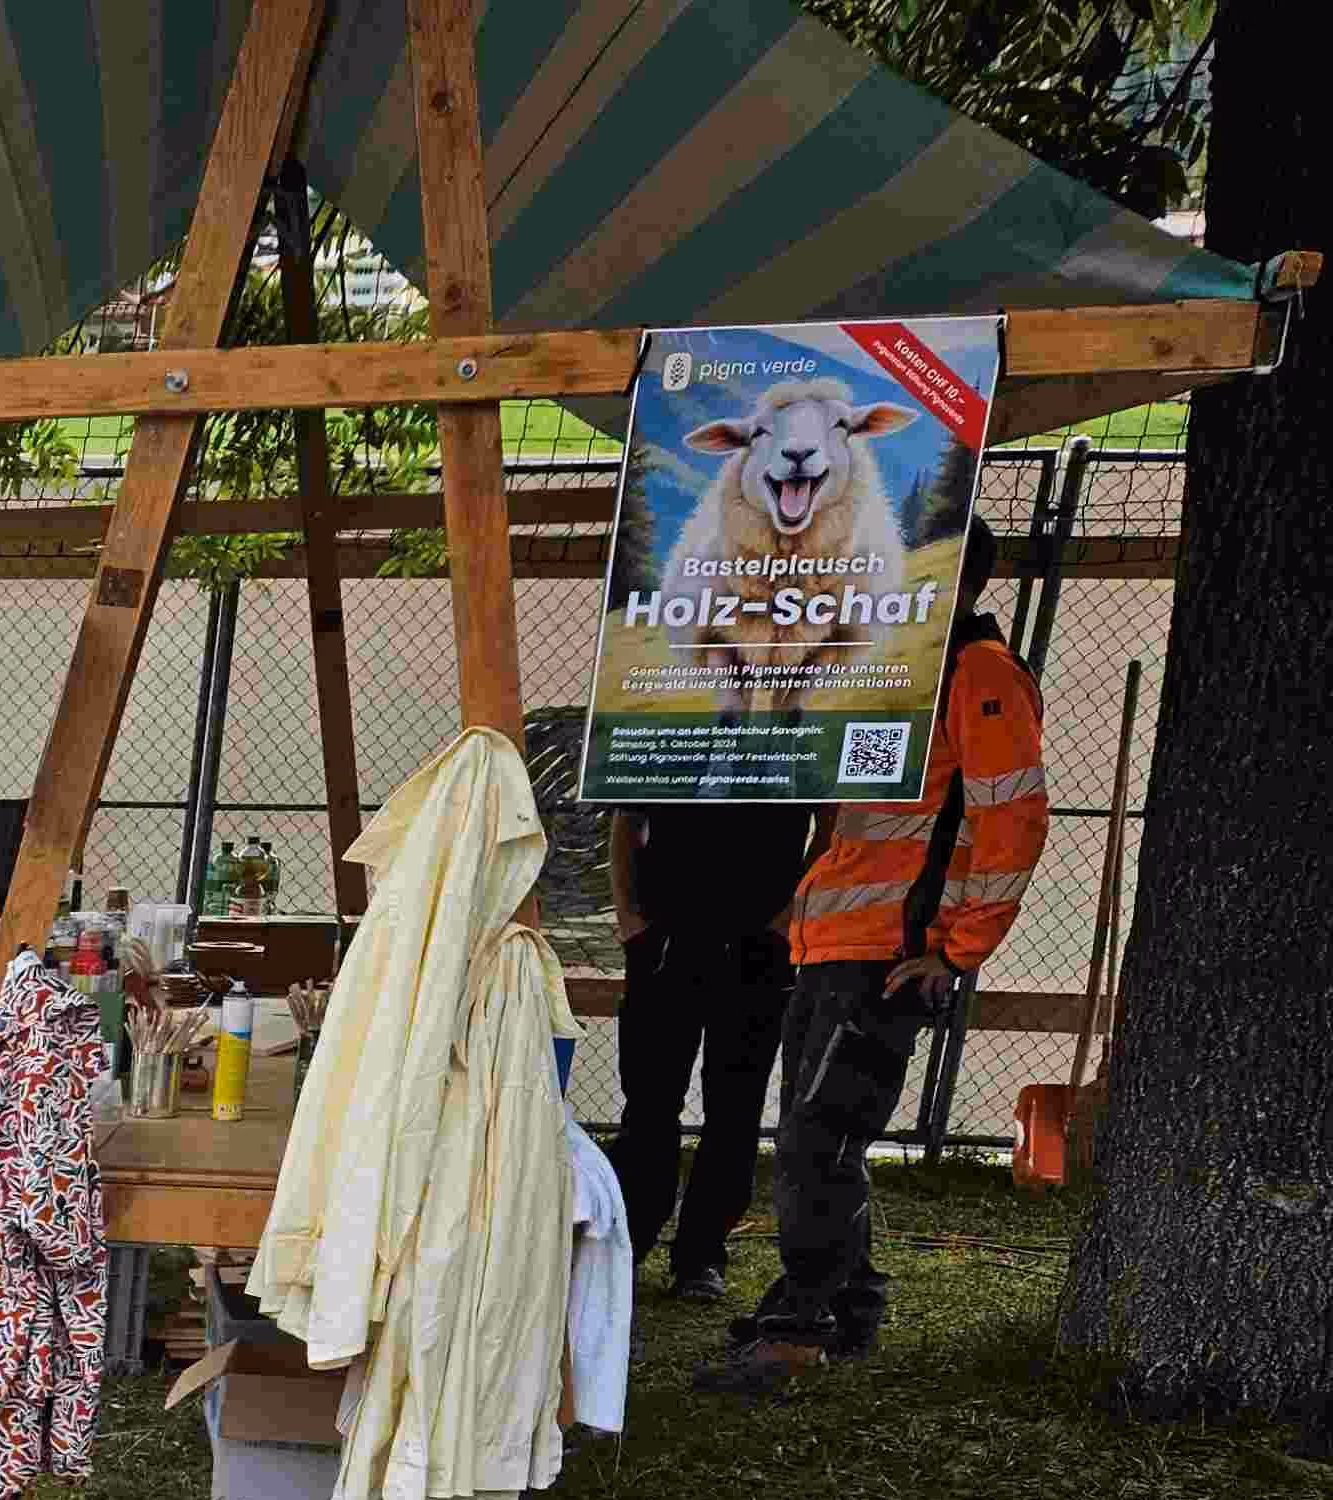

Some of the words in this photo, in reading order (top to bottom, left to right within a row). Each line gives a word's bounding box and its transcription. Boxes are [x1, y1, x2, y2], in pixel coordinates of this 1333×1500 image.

[699, 359, 756, 381] pigna
[761, 356, 816, 374] verde
[893, 338, 928, 373] Kosten
[683, 552, 885, 582] Bastelplausch
[624, 580, 939, 627] Holz-Schaf
[688, 679, 717, 689] und
[718, 678, 741, 689] die
[743, 677, 811, 689] nächsten
[813, 676, 912, 689] Generationen
[714, 663, 738, 675] mit
[825, 663, 846, 674] für
[850, 663, 910, 674] unseren
